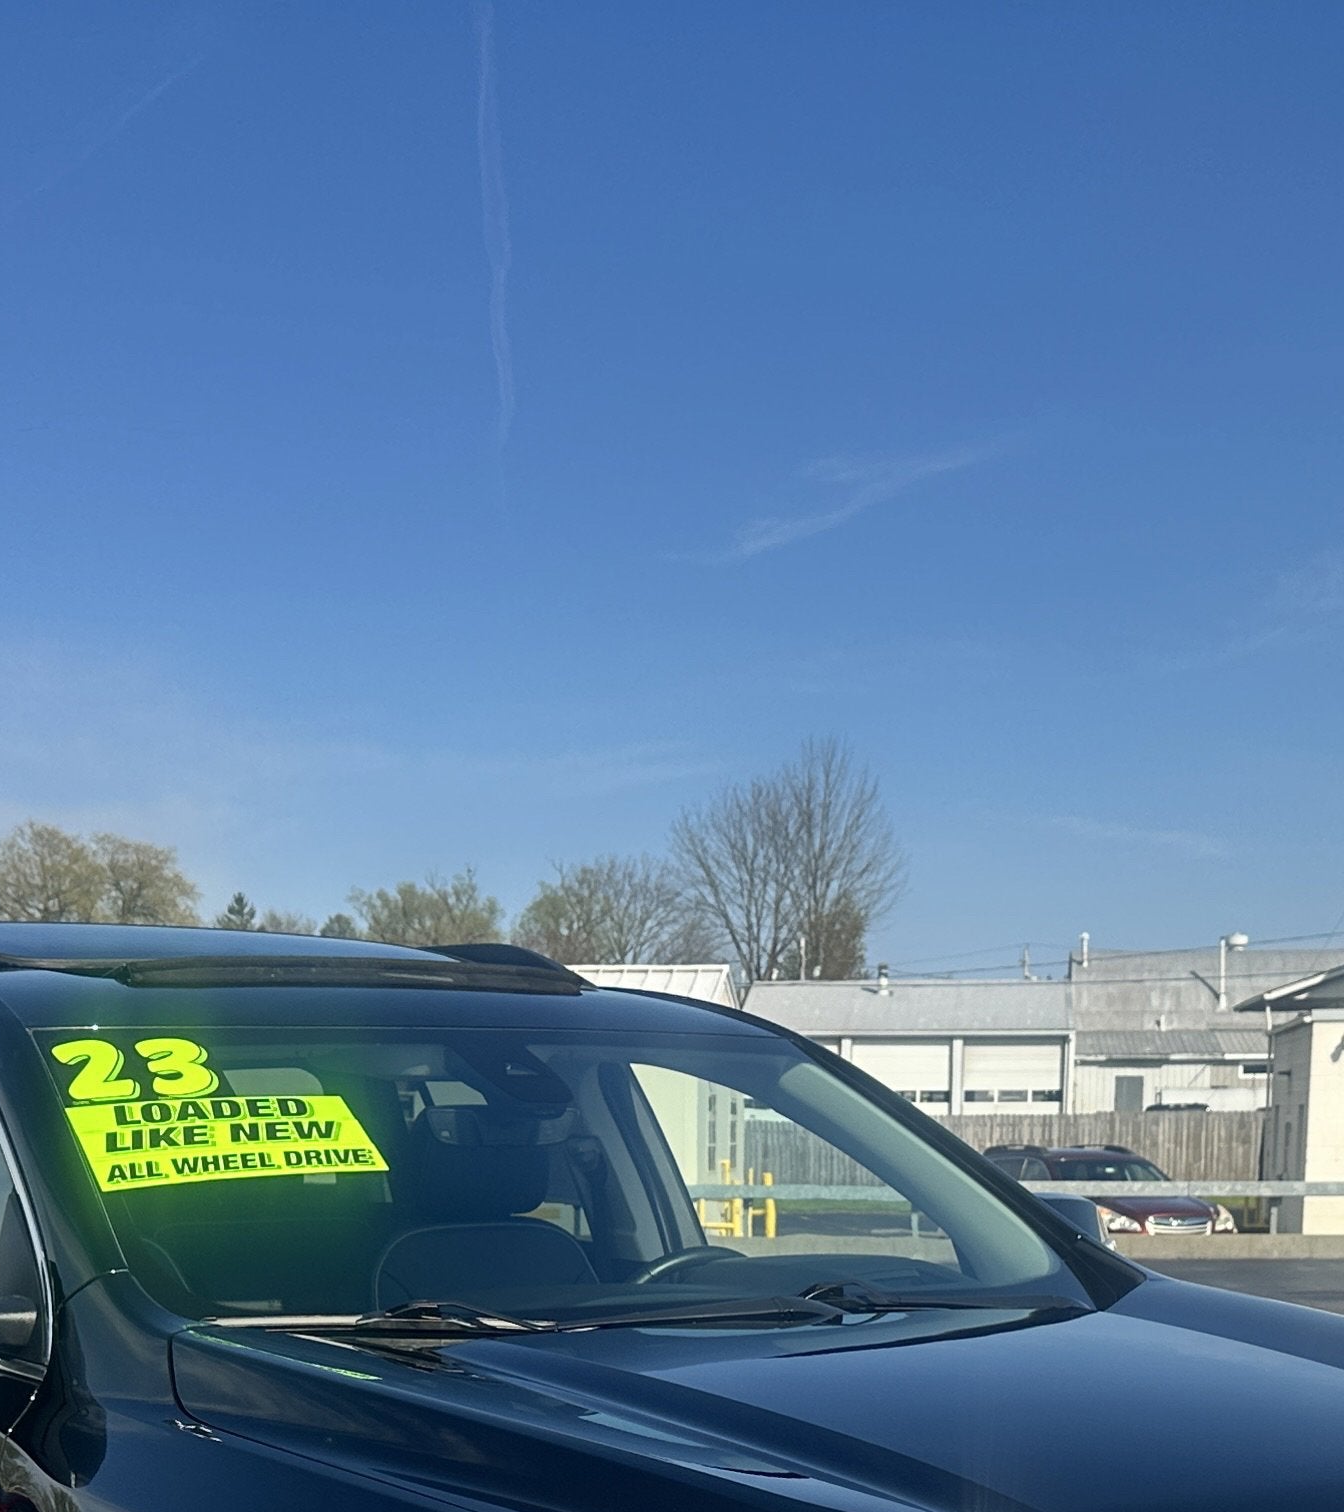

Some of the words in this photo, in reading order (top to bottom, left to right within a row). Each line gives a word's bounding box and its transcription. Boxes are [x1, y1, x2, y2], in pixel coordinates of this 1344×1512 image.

[51, 1037, 220, 1100] 23
[113, 1097, 313, 1127] LOADED
[105, 1125, 215, 1154] LIKE
[229, 1120, 340, 1145] NEW
[107, 1158, 166, 1184] ALL
[171, 1150, 276, 1176] WHEEL
[285, 1147, 372, 1169] DRIVE
